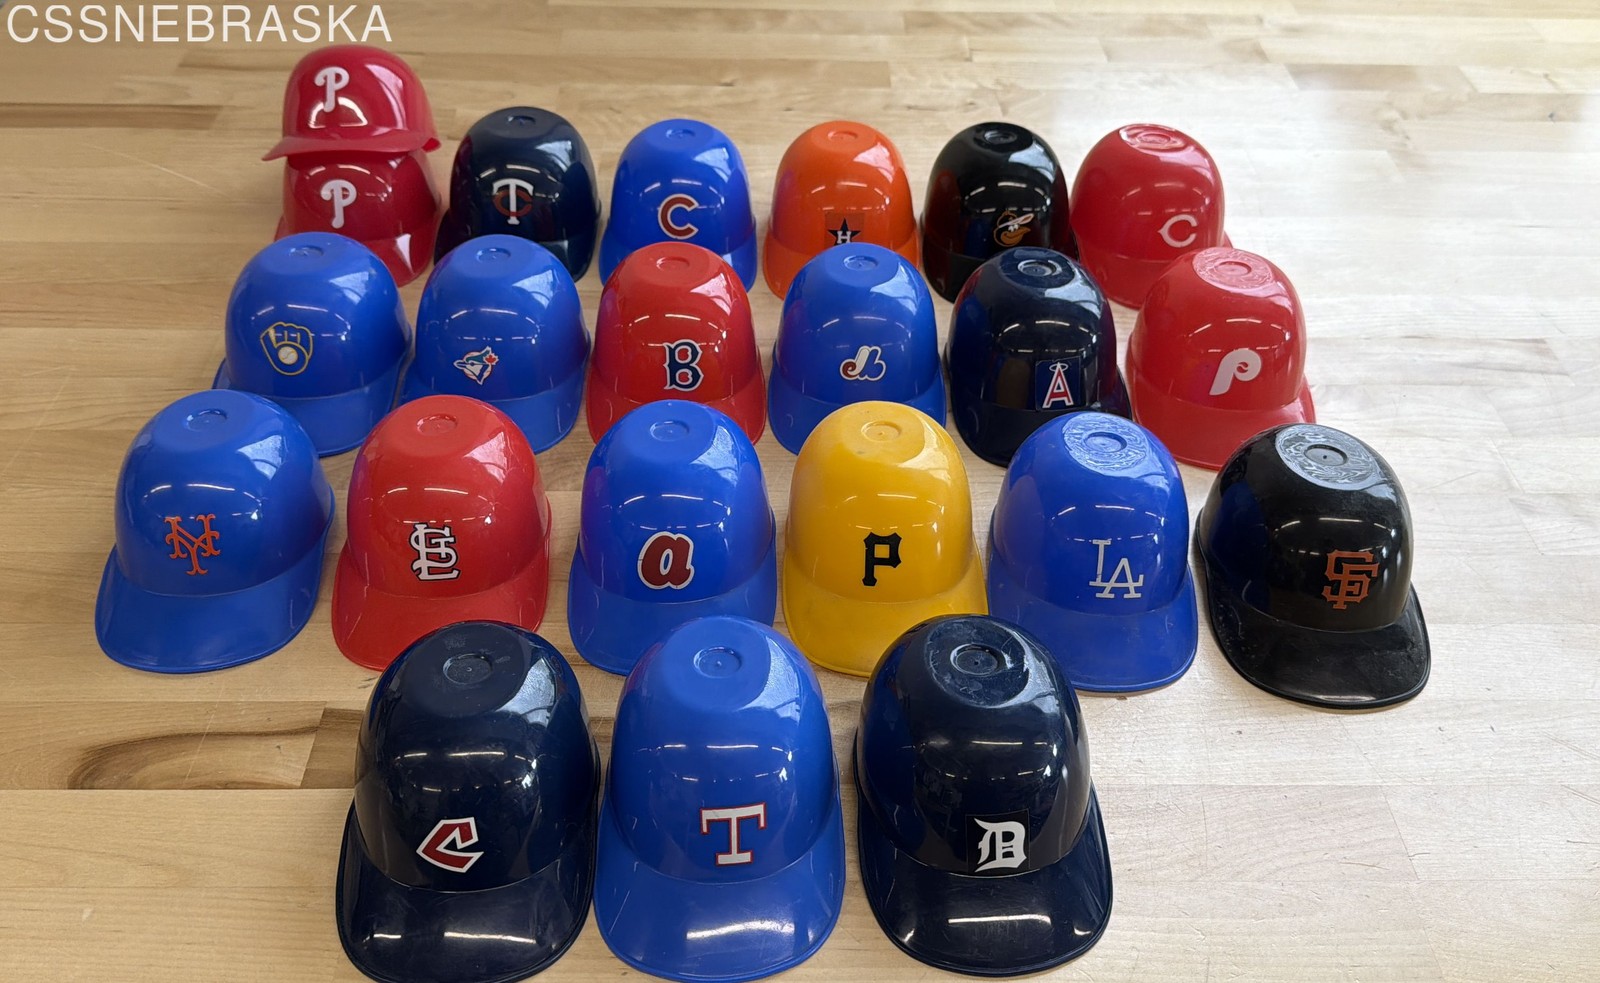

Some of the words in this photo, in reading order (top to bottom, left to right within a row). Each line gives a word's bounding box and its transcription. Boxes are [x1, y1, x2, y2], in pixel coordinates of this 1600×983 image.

[314, 66, 350, 113] P
[320, 179, 357, 229] P
[658, 194, 698, 240] C
[1158, 214, 1197, 248] C
[663, 339, 704, 391] B
[1043, 362, 1073, 410] A
[1209, 348, 1262, 397] P
[862, 532, 902, 587] P
[1089, 539, 1144, 599] LA
[1323, 550, 1379, 610] SF
[416, 817, 484, 874] C
[700, 803, 766, 865] T
[977, 818, 1028, 870] D
